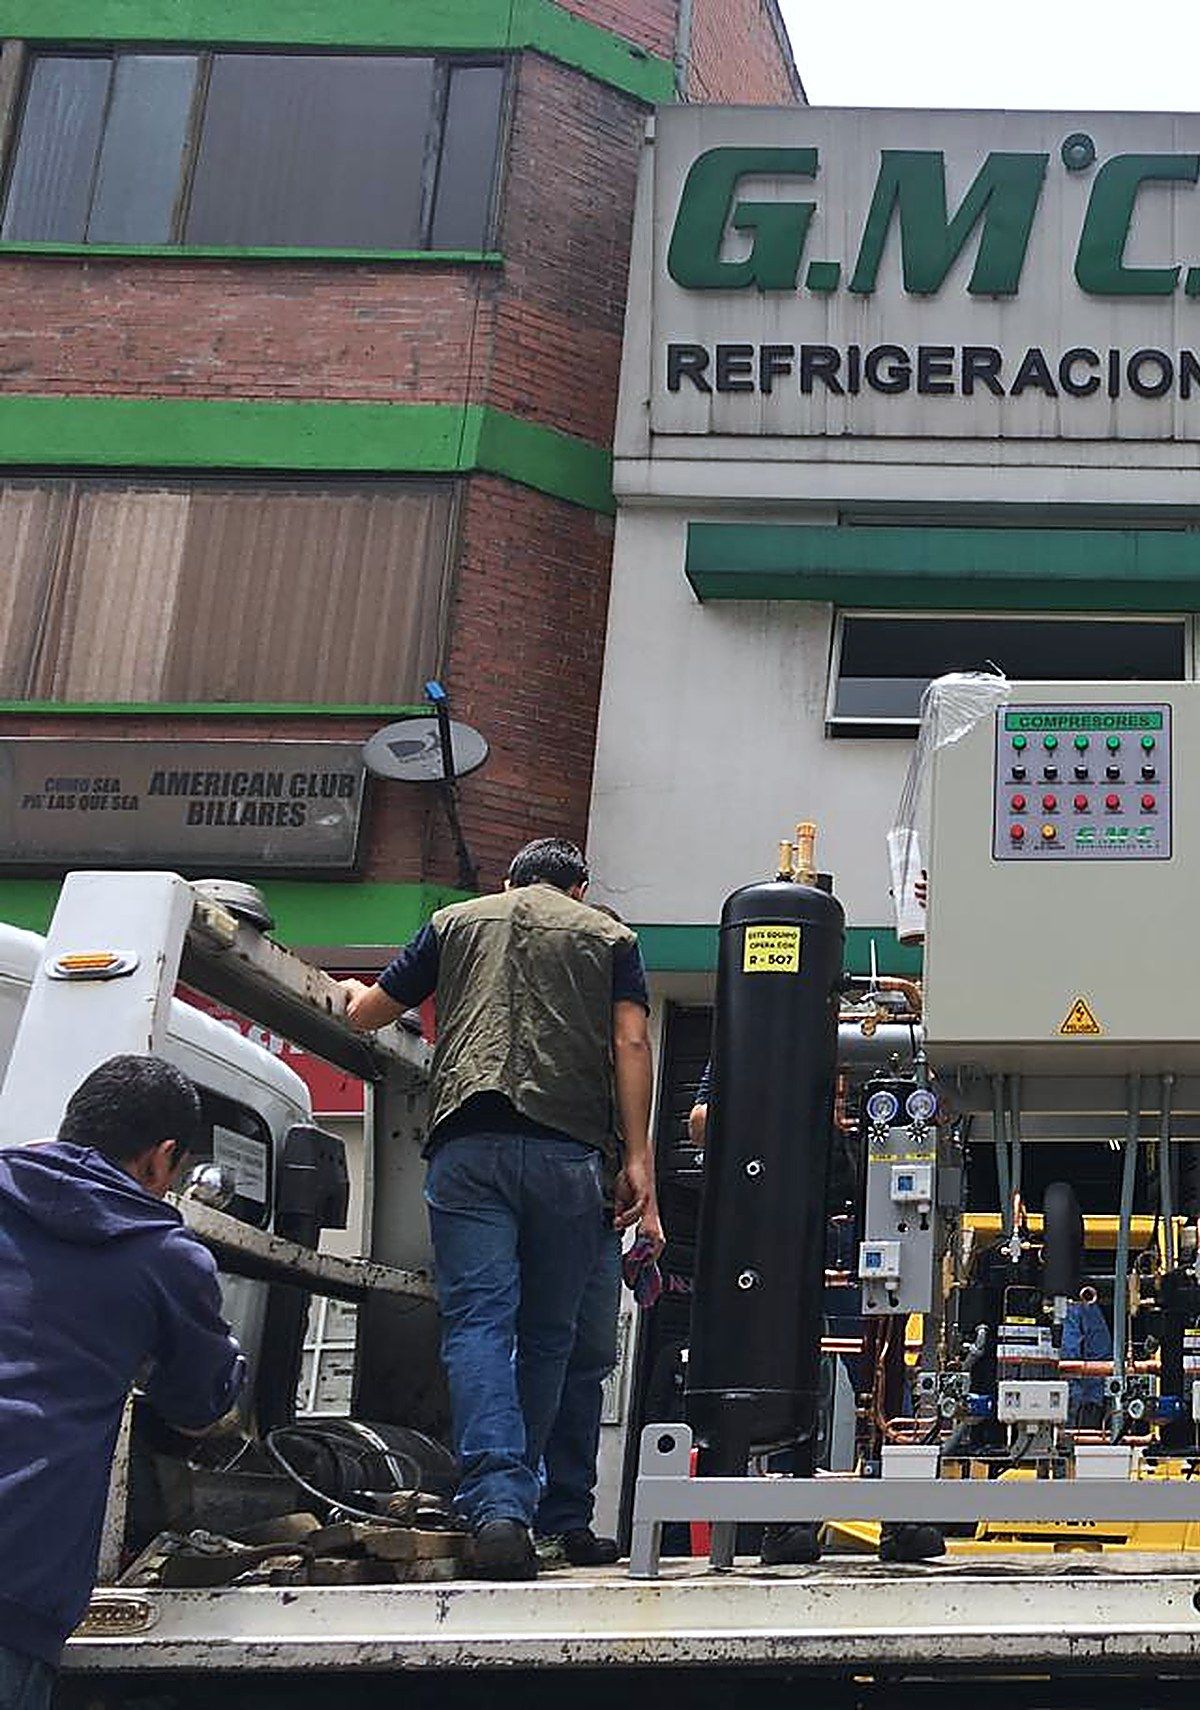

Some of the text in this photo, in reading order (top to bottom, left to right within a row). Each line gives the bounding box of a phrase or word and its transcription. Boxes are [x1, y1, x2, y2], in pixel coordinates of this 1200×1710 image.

[1019, 715, 1150, 728] COMPRESORES
[148, 771, 355, 797] AMERICAN CLUB
[186, 801, 306, 827] BILLARES
[768, 954, 793, 964] 507
